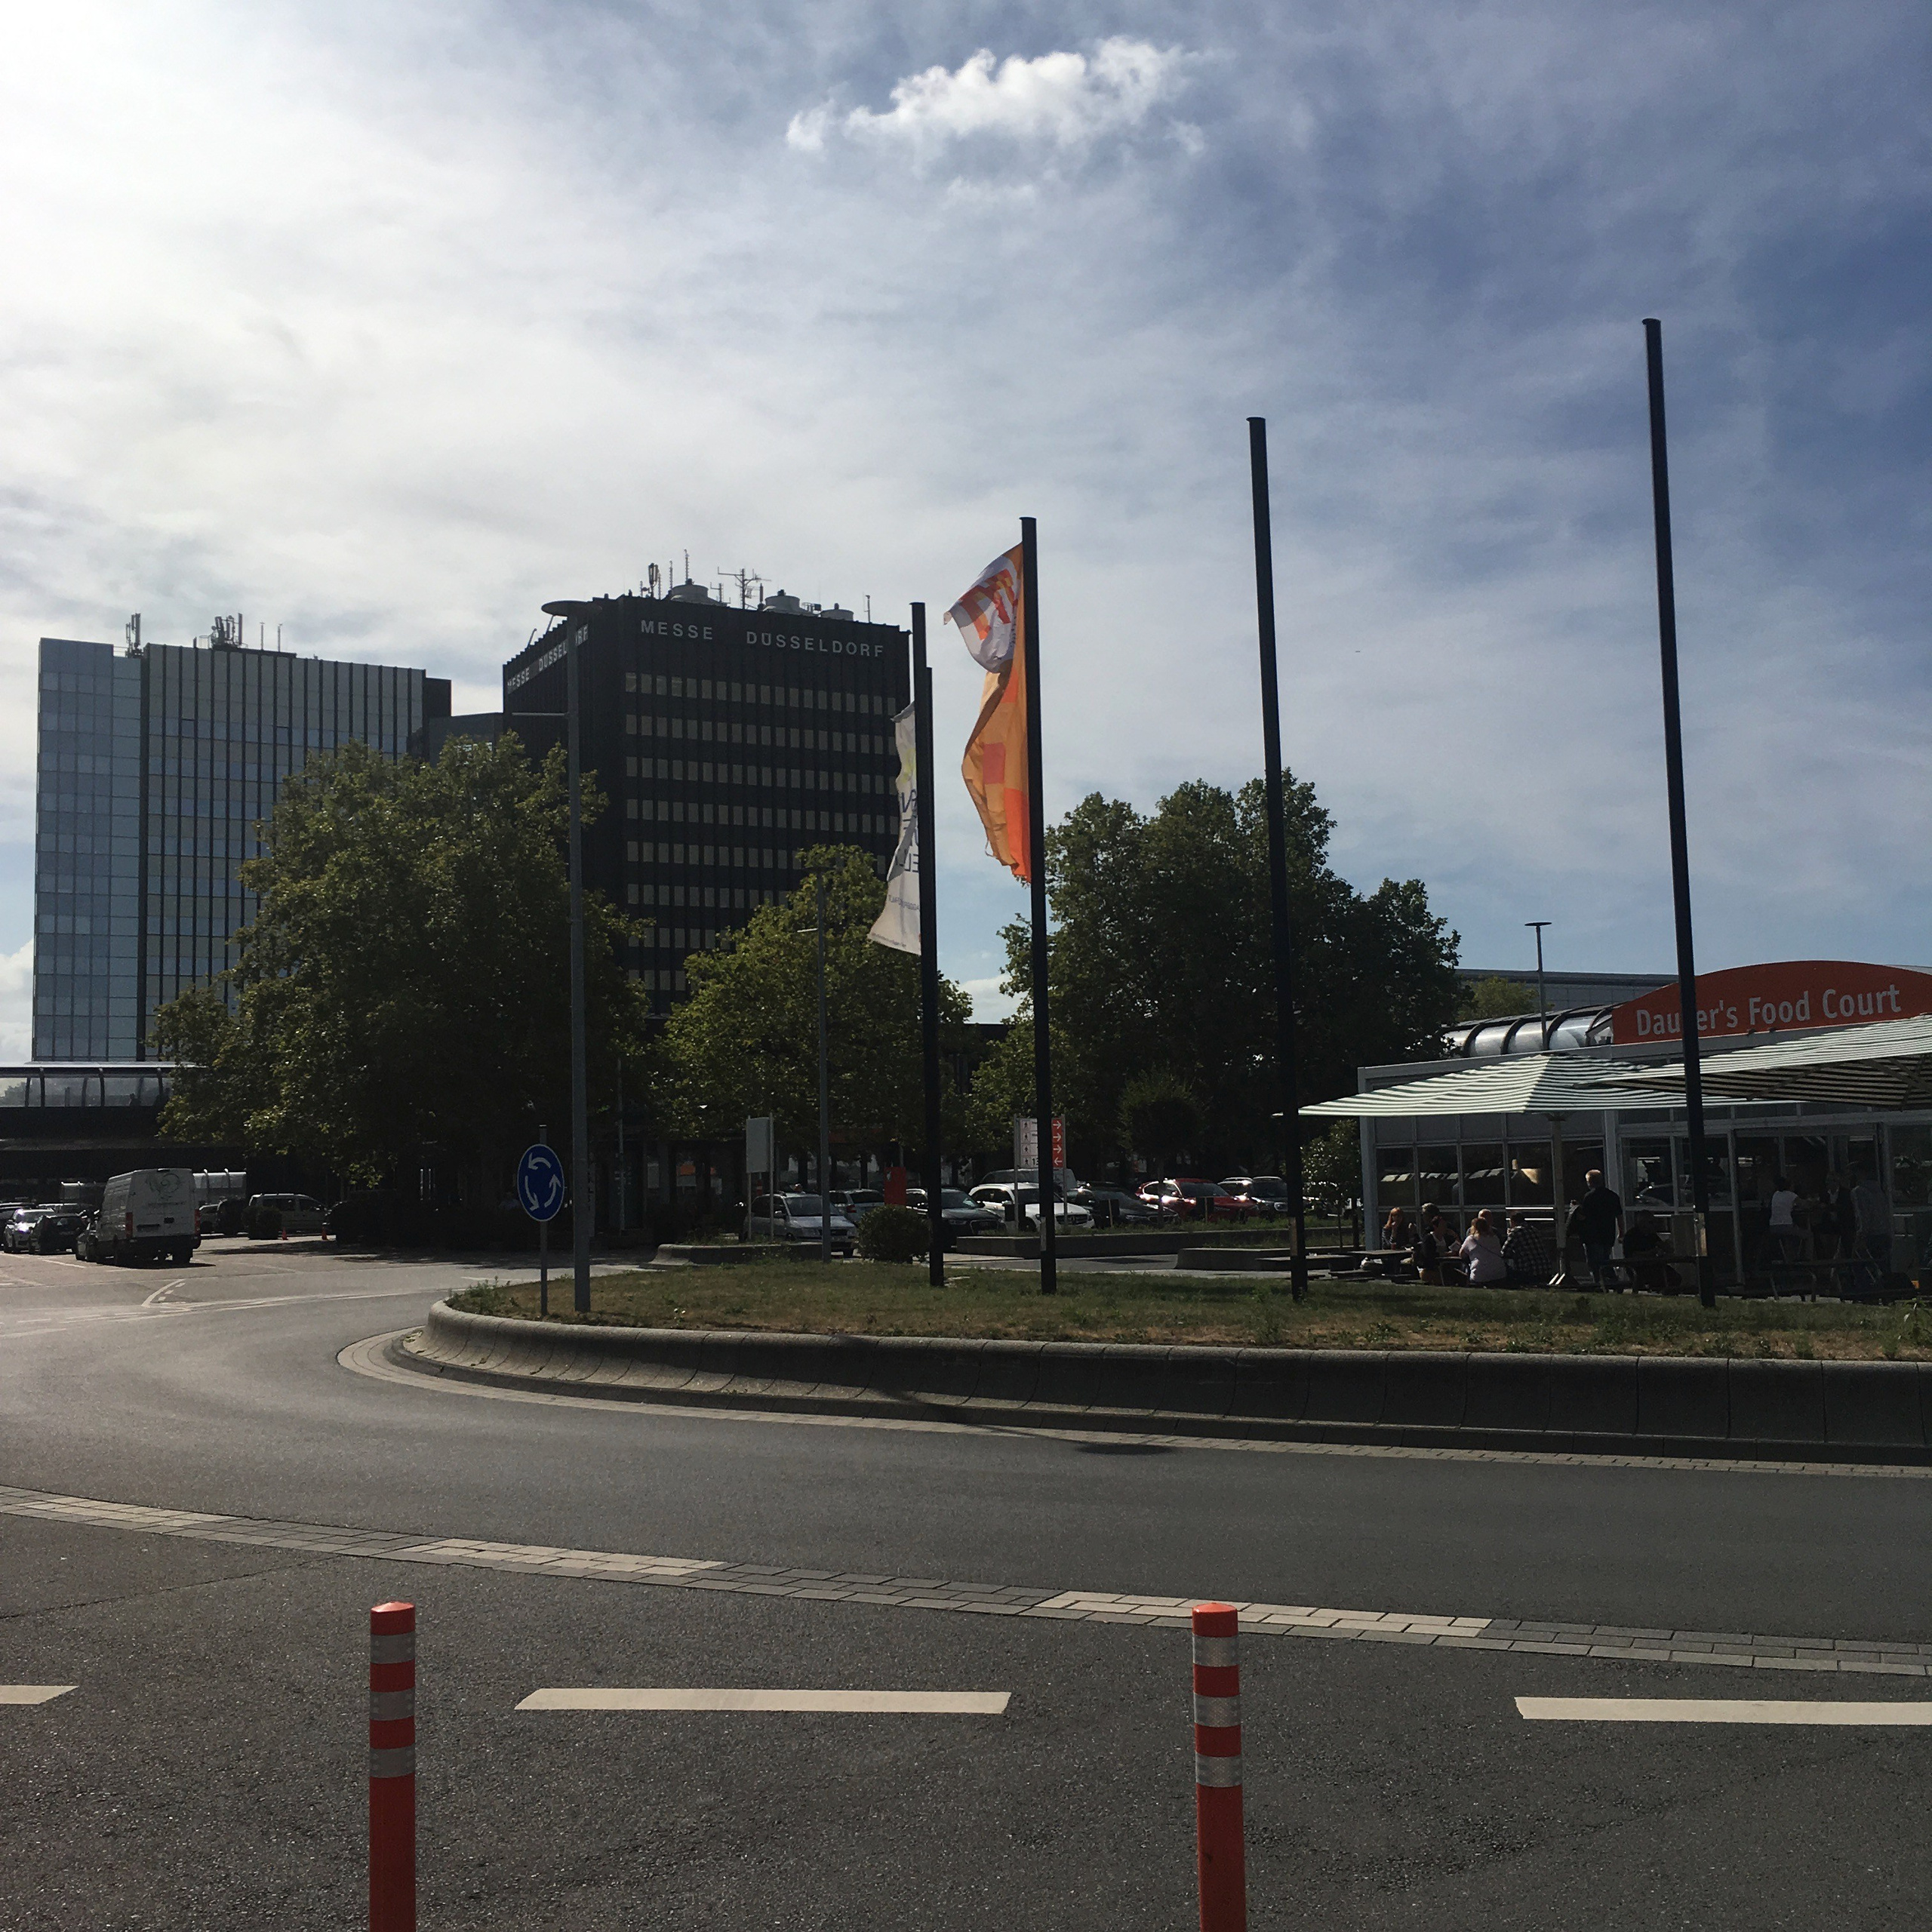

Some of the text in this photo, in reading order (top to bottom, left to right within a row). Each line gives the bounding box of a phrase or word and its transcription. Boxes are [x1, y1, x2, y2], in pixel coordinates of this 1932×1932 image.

[641, 619, 883, 657] MESSE DÜSSELDORF
[1636, 984, 1901, 1036] Dauer's Food Court
